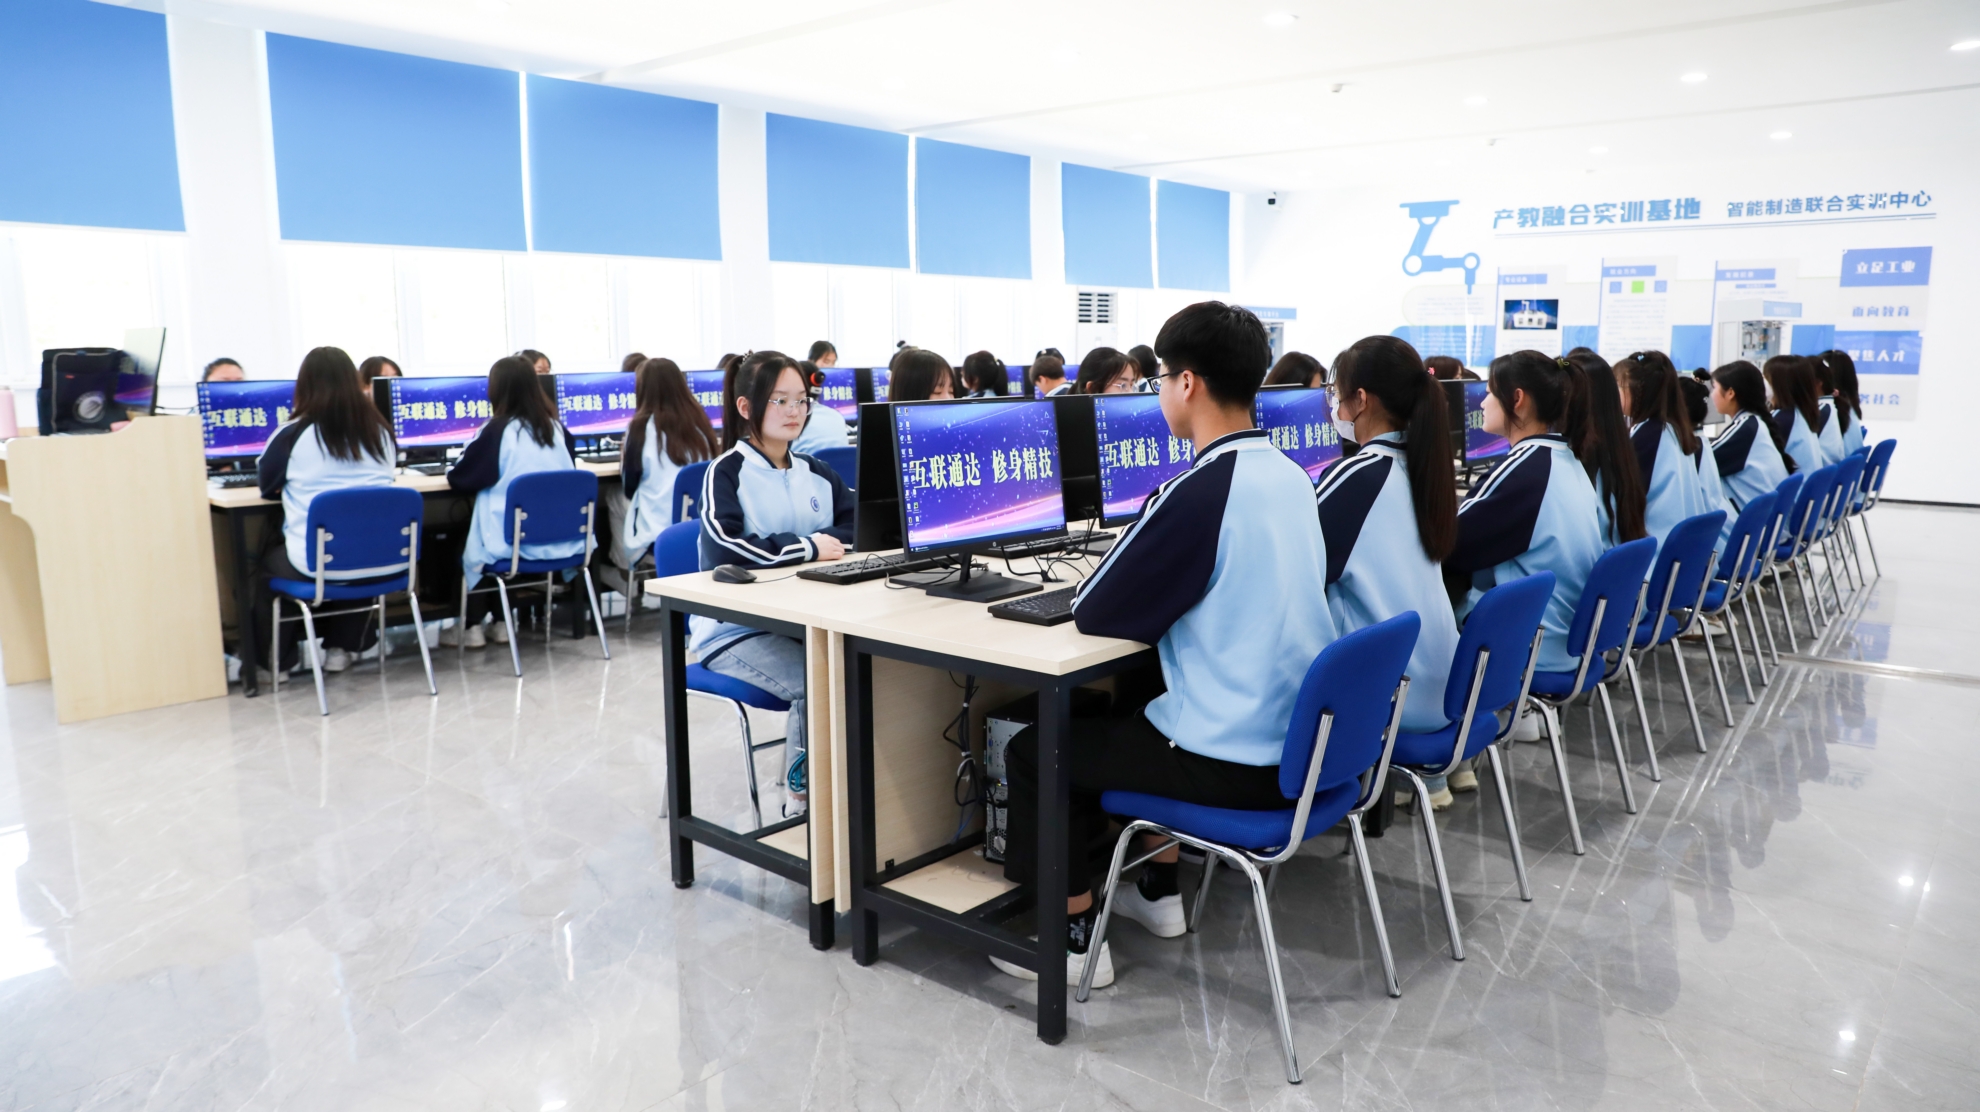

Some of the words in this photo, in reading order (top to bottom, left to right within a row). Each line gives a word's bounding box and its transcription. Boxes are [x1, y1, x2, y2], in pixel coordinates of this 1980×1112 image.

[1493, 197, 1701, 229] 产教融合实训基地
[1727, 190, 1932, 218] 智能制造联合实训中心
[1855, 260, 1916, 274] 立足工业
[563, 394, 603, 411] 互联通达
[608, 392, 637, 410] 修身精
[1858, 393, 1900, 405] 务社会
[207, 407, 268, 428] 互联通达
[398, 401, 447, 420] 互联通达
[1105, 436, 1160, 469] 互联通达
[1168, 434, 1198, 464] 修身
[913, 452, 982, 490] 互联通达
[991, 447, 1054, 484] 修身精技
